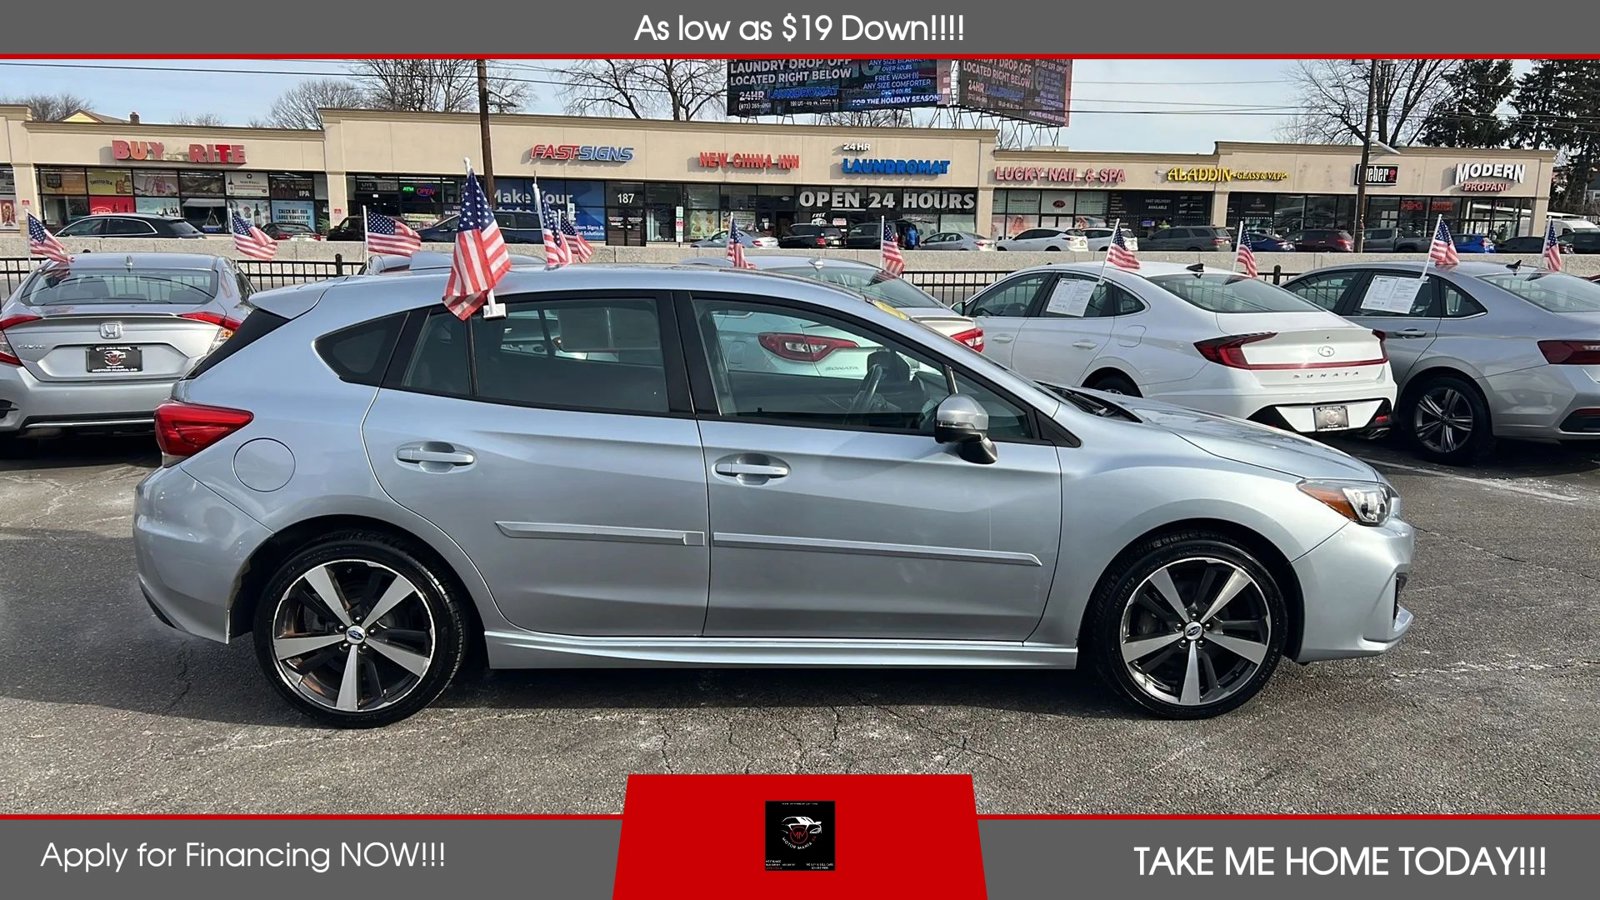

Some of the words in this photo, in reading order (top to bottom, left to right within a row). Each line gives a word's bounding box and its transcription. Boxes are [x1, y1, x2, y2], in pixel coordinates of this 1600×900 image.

[730, 59, 786, 74] LAUNDRY
[789, 59, 824, 69] DROP
[963, 60, 992, 78] LOCATED
[992, 69, 1010, 82] RIGHT
[730, 74, 776, 86] LOCATED
[778, 71, 810, 83] RIGHT
[812, 68, 852, 80] BELOW
[891, 71, 910, 80] WASH
[891, 79, 931, 88] COMFORTER
[880, 96, 911, 104] HOLIDAY
[112, 140, 165, 160] BUY
[188, 144, 248, 164] RITE
[531, 144, 634, 161] FASTSIGNS
[700, 152, 727, 168] NEW
[733, 153, 772, 169] CHINA
[778, 154, 800, 169] INN
[842, 158, 951, 175] LAUNDROMAT
[996, 166, 1044, 181] LUCKY
[1048, 167, 1081, 182] NAIL
[1085, 168, 1095, 183] &
[1099, 168, 1126, 183] SPA
[1167, 167, 1232, 183] ALADDIN
[1364, 166, 1389, 183] eber
[1455, 163, 1526, 185] MODERN
[542, 190, 573, 204] our
[617, 193, 635, 204] 187
[799, 191, 861, 208] OPEN
[868, 192, 895, 208] 24
[902, 193, 975, 209] HOURS
